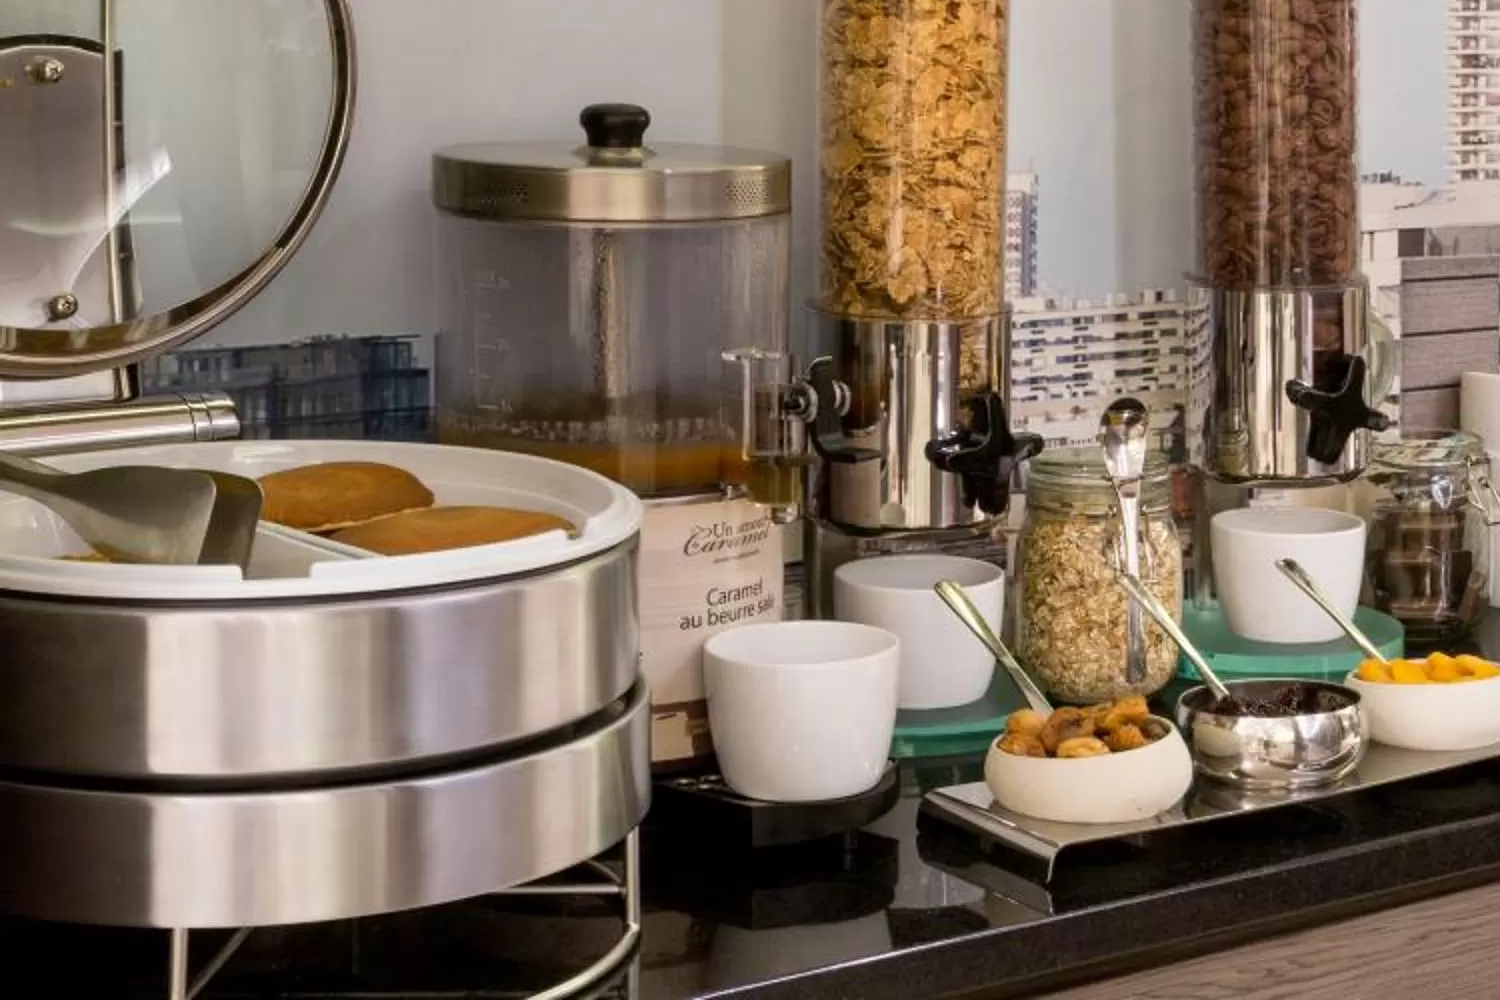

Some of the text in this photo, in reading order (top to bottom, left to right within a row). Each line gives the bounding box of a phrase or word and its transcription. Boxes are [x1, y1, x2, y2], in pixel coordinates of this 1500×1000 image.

[706, 575, 763, 607] Caramel
[679, 614, 703, 631] au
[707, 607, 755, 627] beurre
